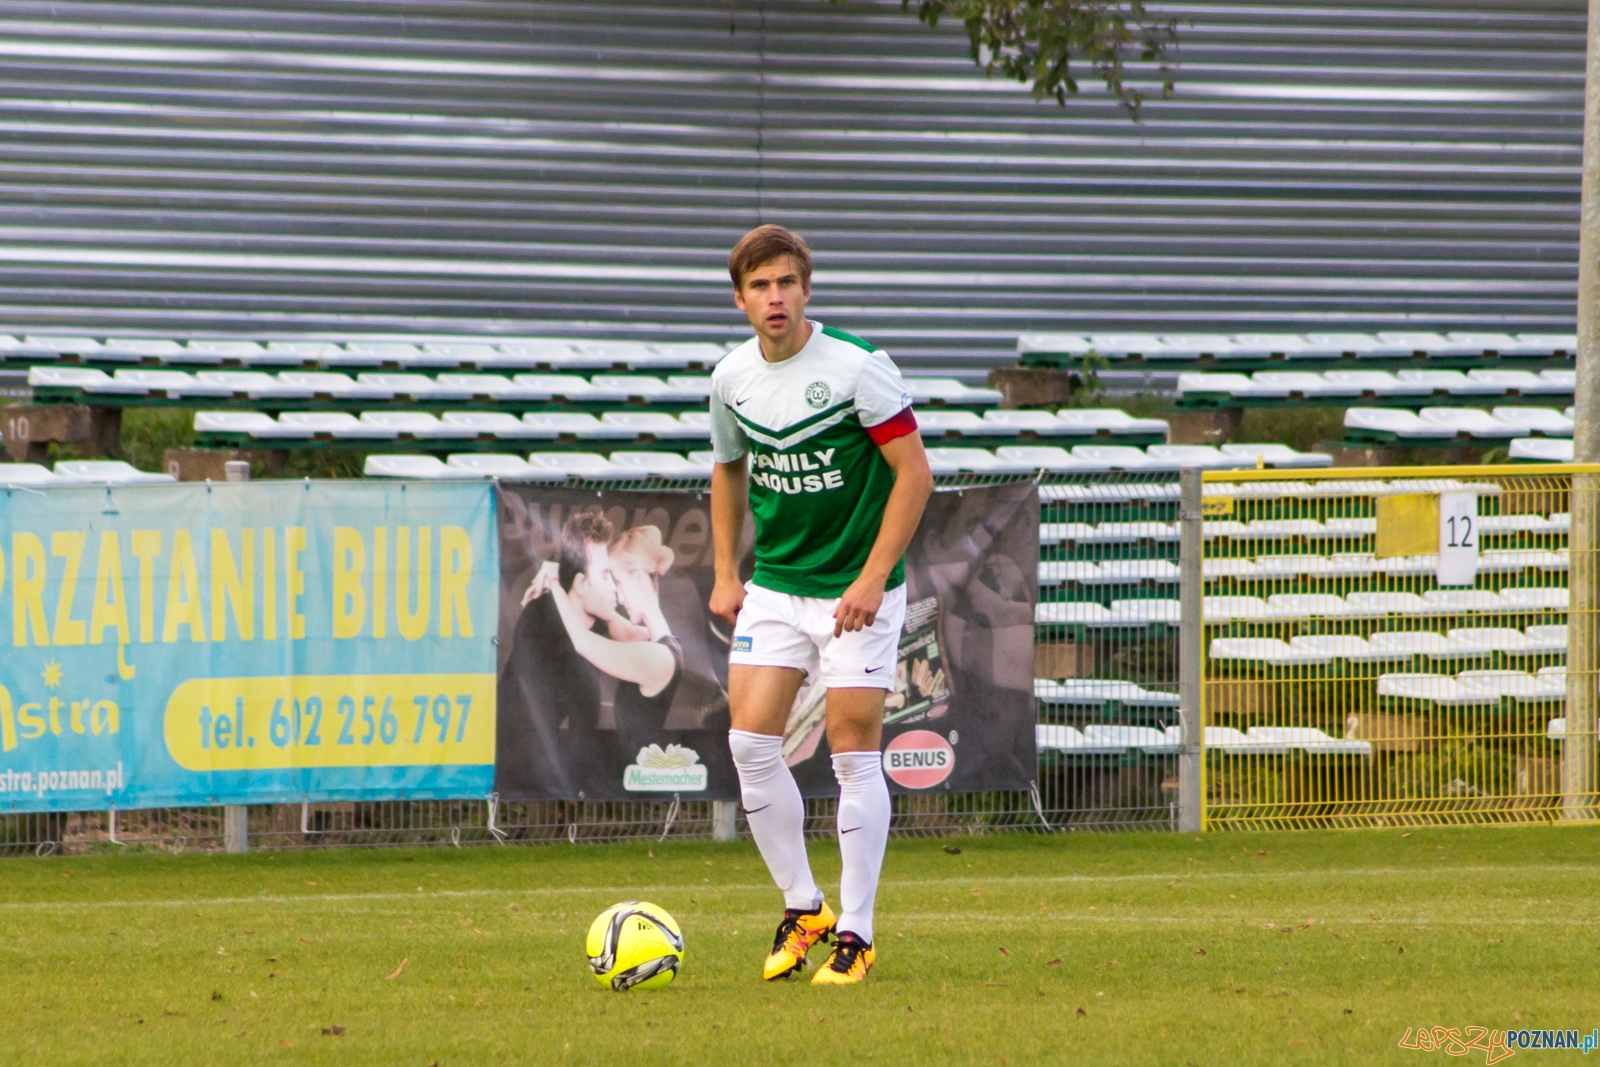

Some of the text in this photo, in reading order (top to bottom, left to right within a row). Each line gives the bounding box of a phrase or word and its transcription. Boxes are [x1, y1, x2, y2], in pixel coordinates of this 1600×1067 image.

[9, 416, 30, 440] 10
[754, 448, 835, 472] AMILY
[751, 469, 844, 495] HOUSE
[1447, 515, 1473, 547] 12
[0, 526, 306, 680] RZĄTANIE
[333, 525, 475, 640] BIUR
[199, 693, 473, 750] tel. 602 256 797
[890, 751, 947, 768] BENUS
[628, 768, 703, 786] Mestemacher
